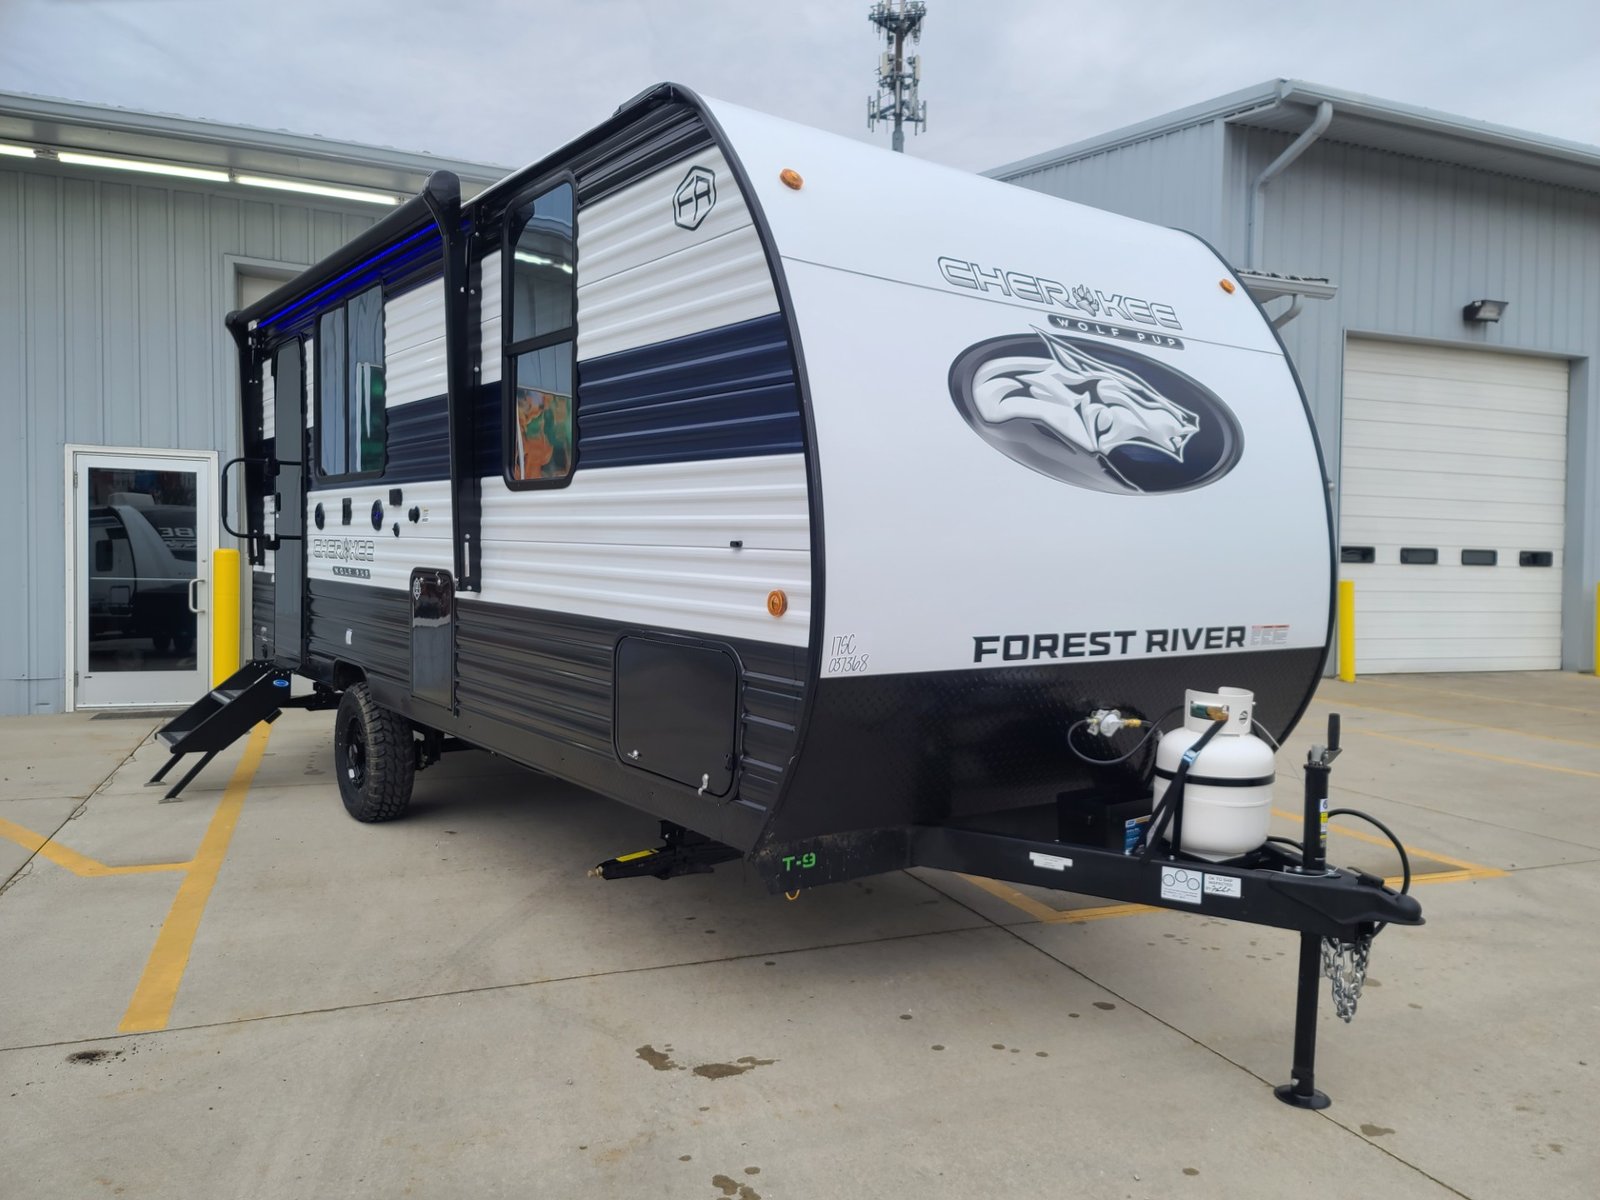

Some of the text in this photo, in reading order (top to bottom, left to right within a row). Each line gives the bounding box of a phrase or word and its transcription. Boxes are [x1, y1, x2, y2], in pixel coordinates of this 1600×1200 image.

[938, 256, 1183, 330] CHEROKEE
[1056, 317, 1176, 347] WOLF PUP
[972, 630, 1137, 663] FOREST
[1145, 625, 1246, 653] RIVER
[828, 653, 870, 673] 037368
[782, 852, 816, 871] T-9
